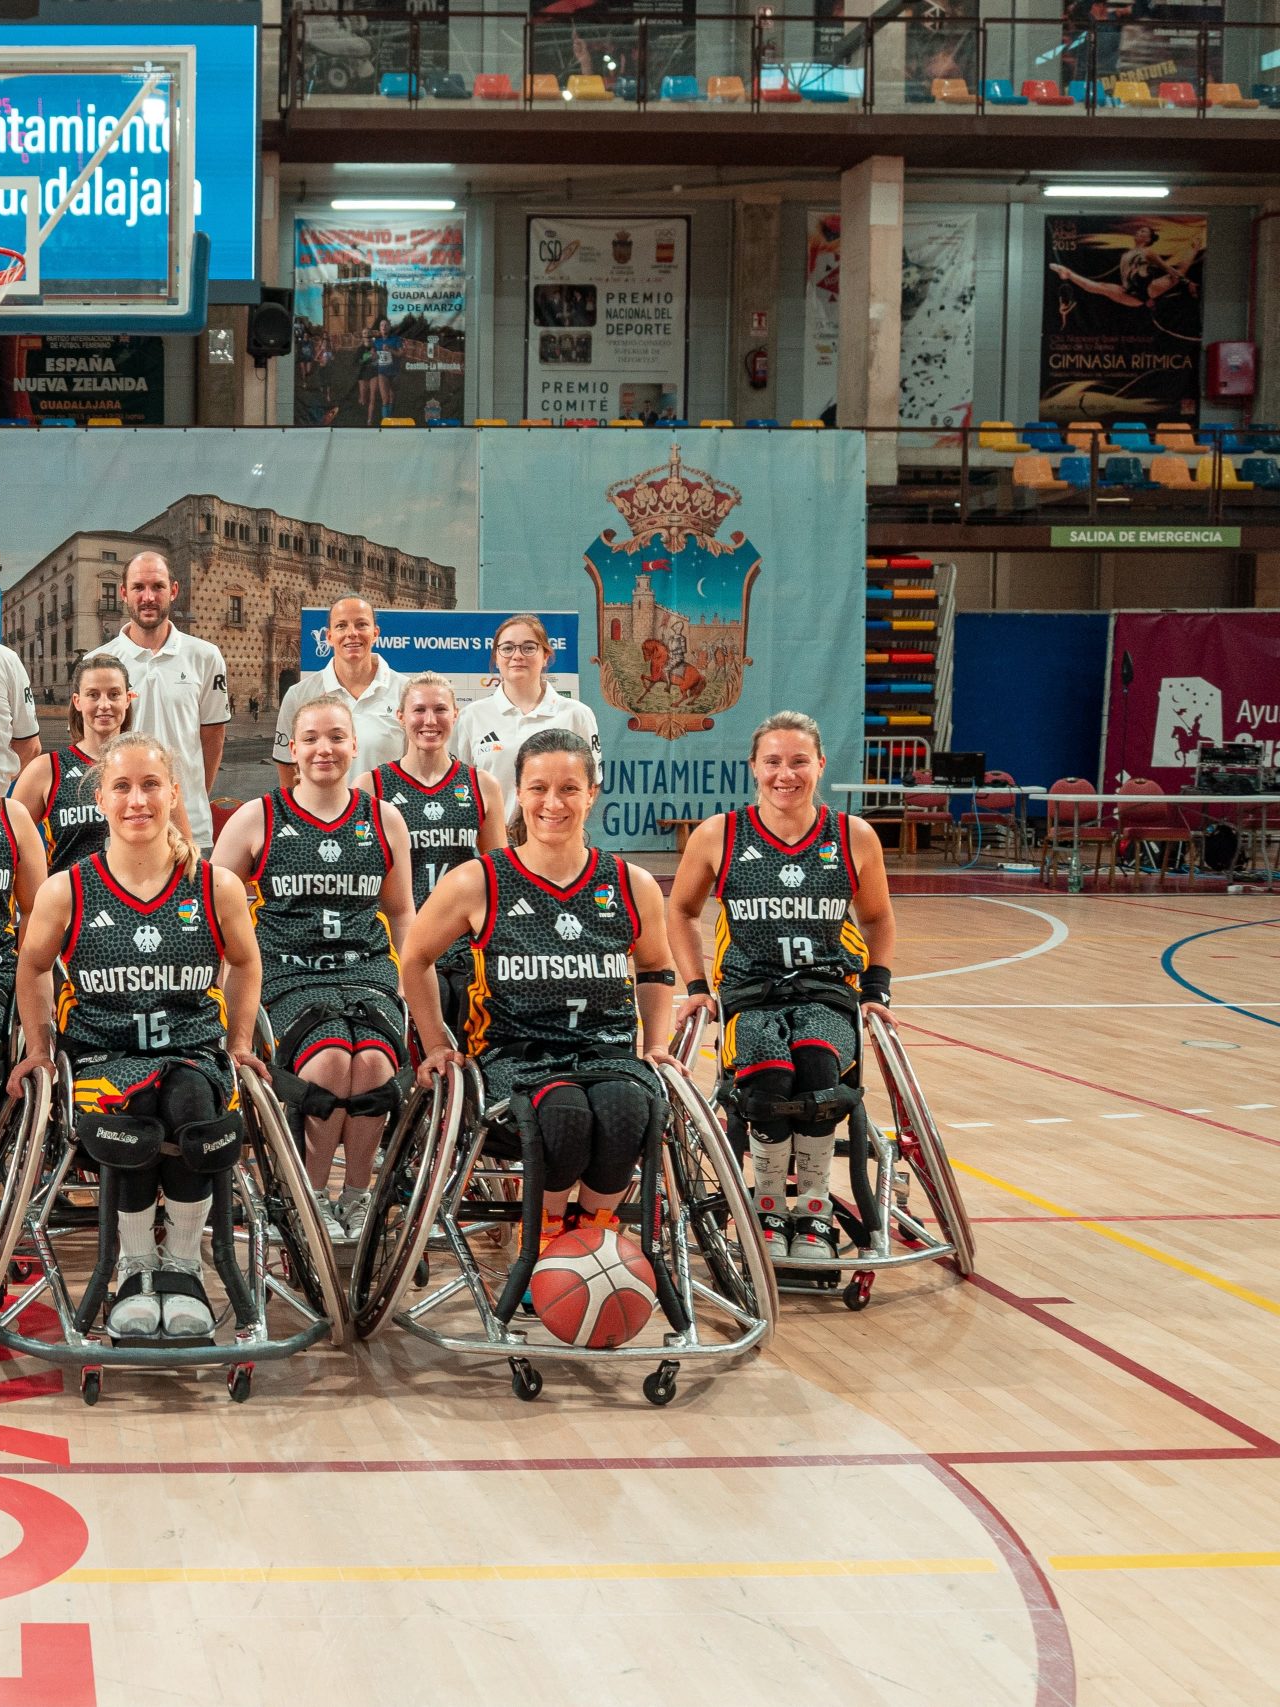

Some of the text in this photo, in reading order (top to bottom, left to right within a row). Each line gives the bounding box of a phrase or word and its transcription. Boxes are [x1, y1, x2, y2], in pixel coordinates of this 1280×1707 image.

[539, 240, 562, 262] CSD
[1053, 241, 1077, 251] 2015
[392, 291, 462, 300] GUADALAJARA
[606, 292, 673, 304] PREMIO
[392, 303, 463, 313] 29 DE MARZO
[606, 307, 672, 320] NACIONAL DEL
[606, 323, 672, 336] DEPORTE
[45, 354, 116, 372] ESPAÑA
[1049, 351, 1193, 369] GIMNASIA RÍTMICA
[13, 377, 149, 392] NUEVA ZELANDA
[542, 381, 609, 394] PREMIO
[39, 400, 122, 410] GUADALAJARA
[541, 396, 608, 412] COMITÉ
[1070, 531, 1223, 543] SALIDA DE EMERGENCIA
[376, 637, 410, 649] IWBF
[602, 759, 751, 795] UNTAMIENT
[271, 873, 383, 897] DEUTSCHLAND
[727, 897, 847, 921] DEUTSCHLAND
[322, 909, 342, 939] 5
[777, 936, 815, 968] 13
[78, 965, 214, 994] DEUTSCHLAND
[566, 999, 588, 1028] 7
[133, 1010, 171, 1050] 15
